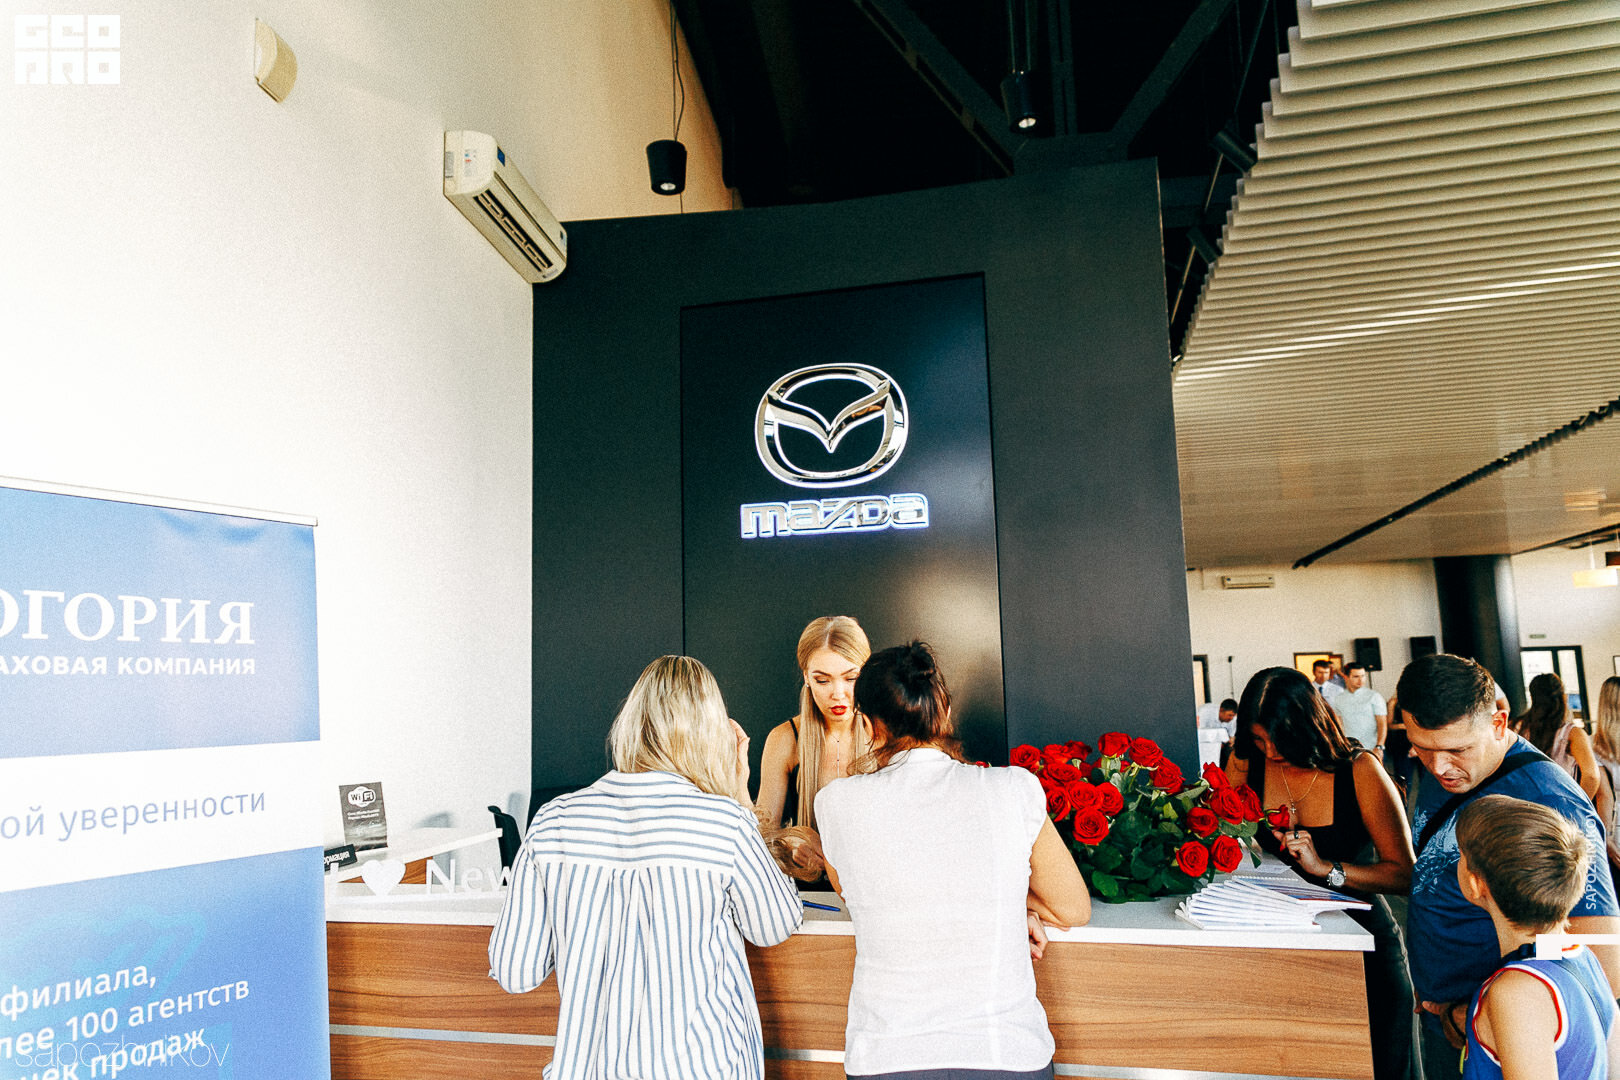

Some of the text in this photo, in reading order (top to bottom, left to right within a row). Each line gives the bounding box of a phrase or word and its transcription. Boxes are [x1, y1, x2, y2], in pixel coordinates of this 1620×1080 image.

[117, 656, 256, 675] КОМПАНИЯ
[0, 792, 266, 842] ой уверенности
[0, 964, 157, 1022] филиала,
[65, 1006, 119, 1042] 100
[127, 980, 249, 1028] агентств
[90, 1028, 206, 1080] продаж
